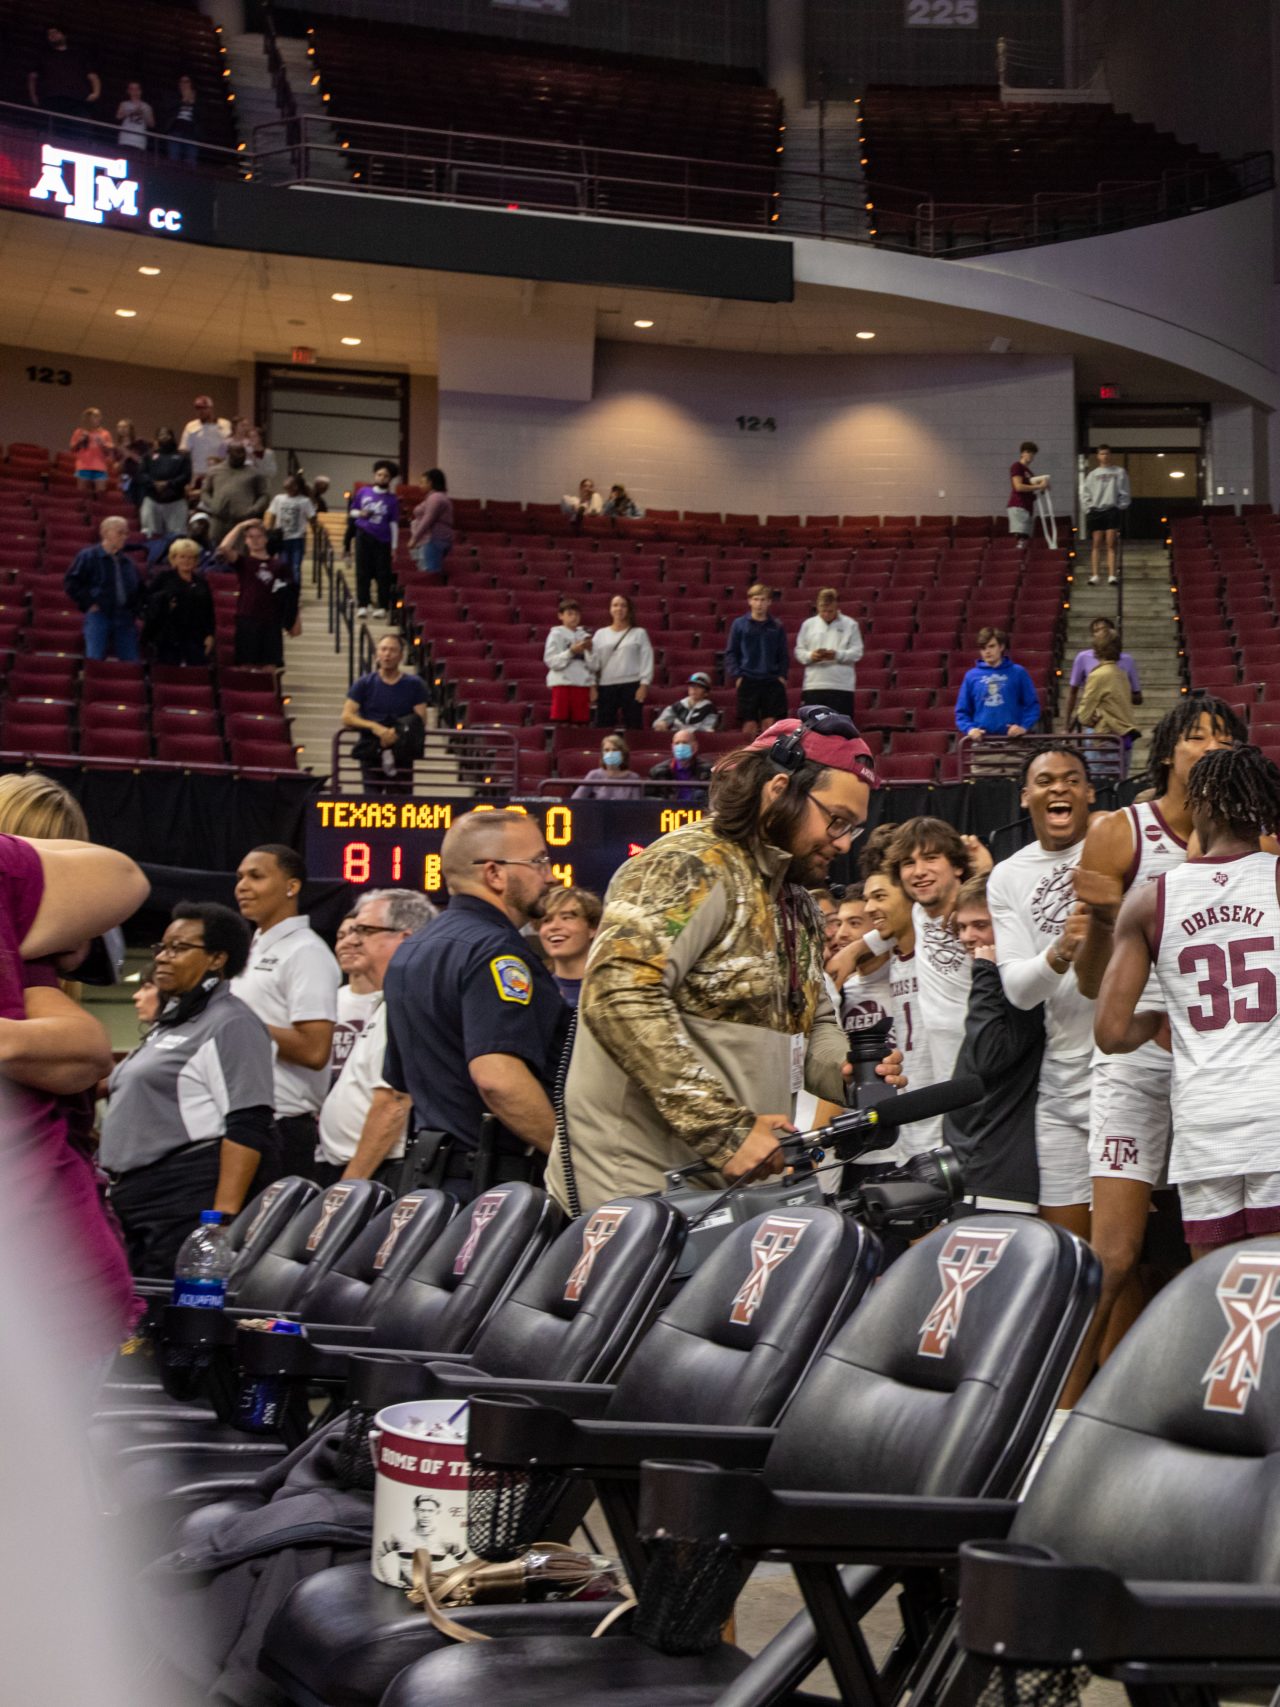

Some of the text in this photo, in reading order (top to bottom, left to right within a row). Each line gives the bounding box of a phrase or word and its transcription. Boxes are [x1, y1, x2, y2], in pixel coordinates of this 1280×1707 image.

[908, 0, 977, 25] 225
[26, 365, 72, 387] 123
[736, 415, 777, 433] 124
[316, 801, 452, 829] TEXAS A&M
[342, 842, 403, 884] 81
[1181, 905, 1265, 936] OBASEKI
[1178, 936, 1278, 1032] 35
[381, 1447, 418, 1472] HOME
[419, 1458, 445, 1475] OF
